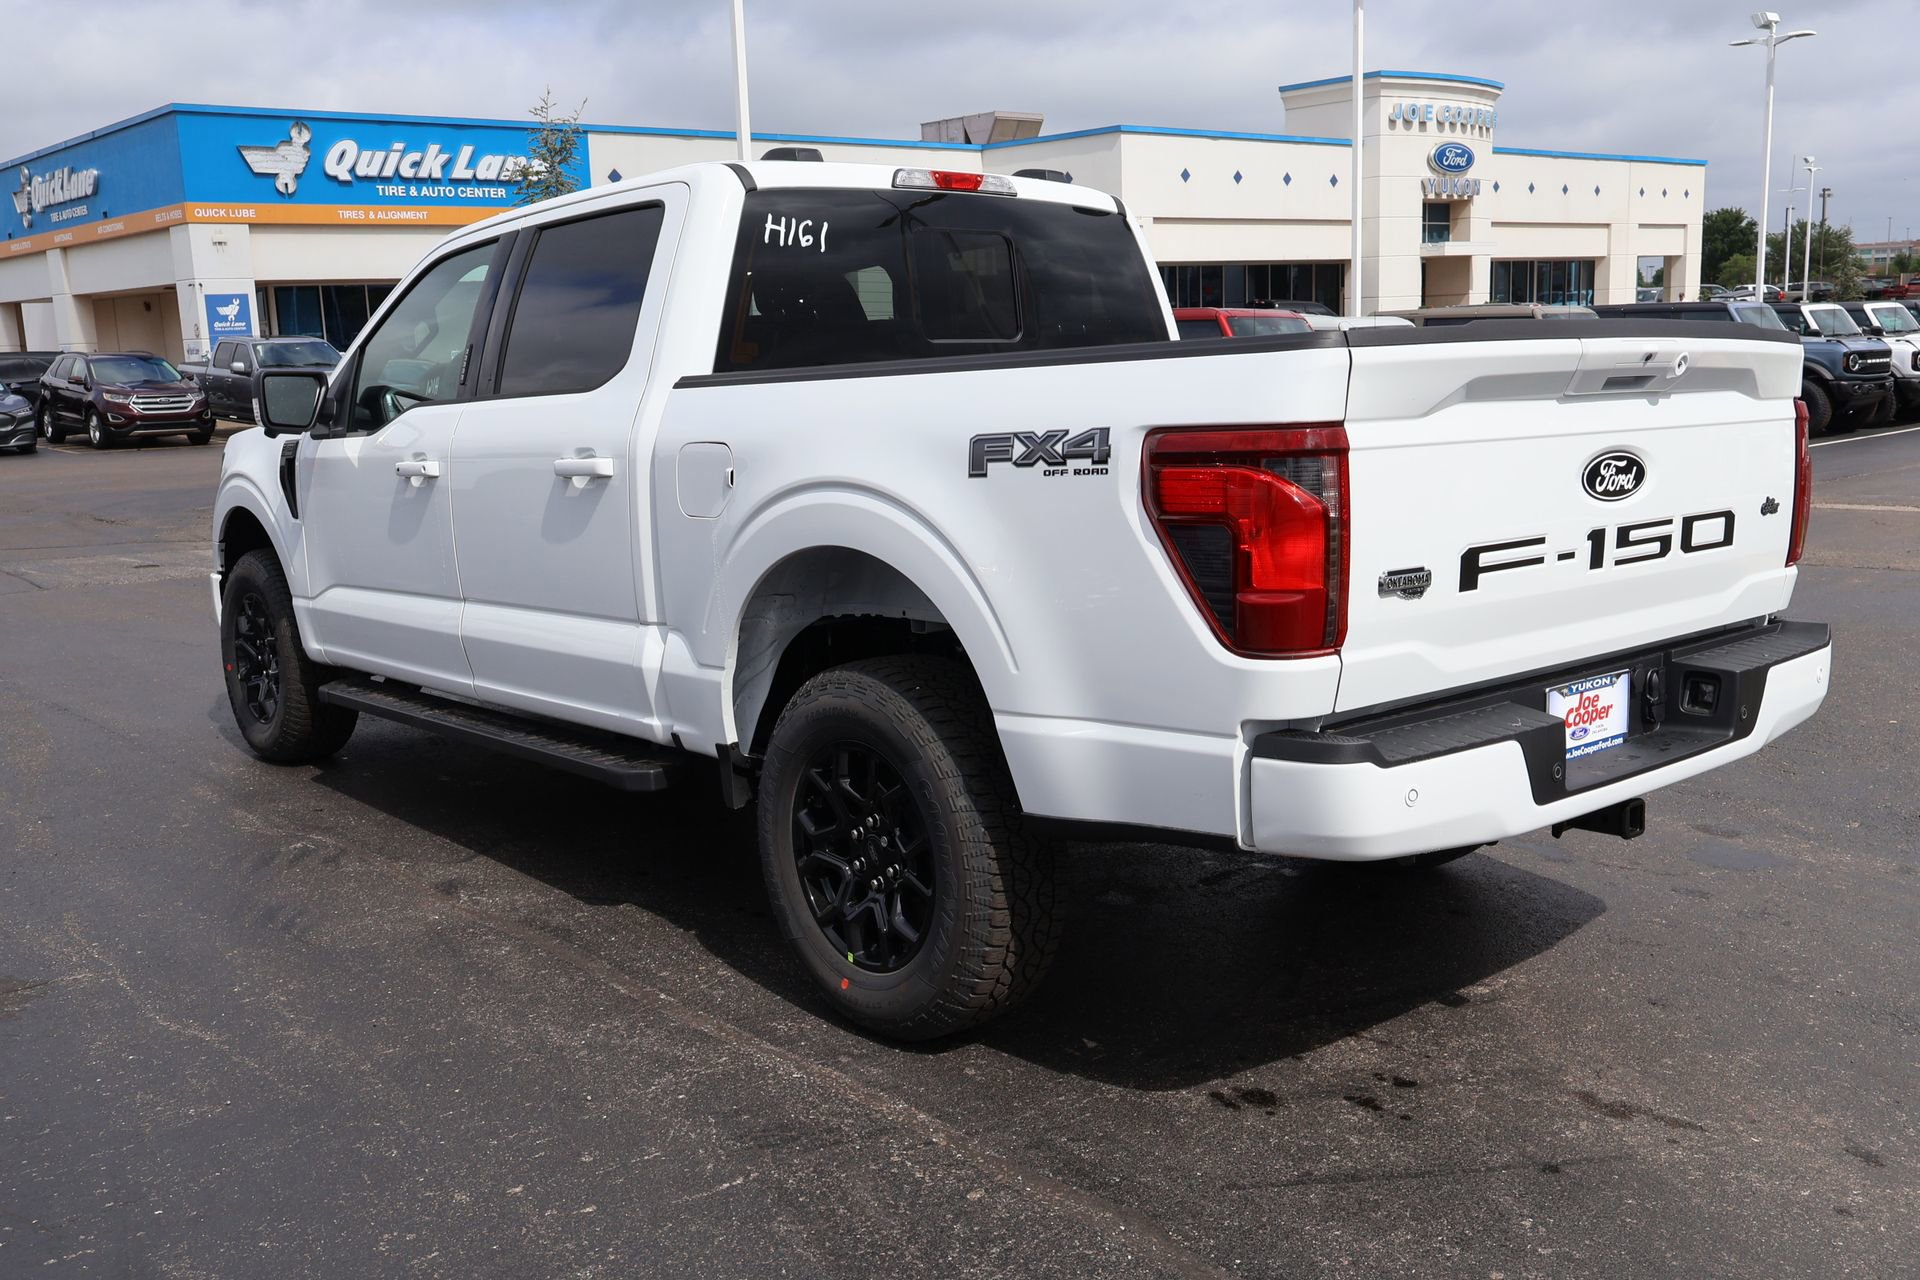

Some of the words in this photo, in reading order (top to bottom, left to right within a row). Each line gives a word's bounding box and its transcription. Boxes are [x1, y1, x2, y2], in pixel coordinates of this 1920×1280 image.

[1389, 103, 1434, 121] JOE
[1437, 105, 1498, 129] COOPER
[324, 139, 451, 182] Quick
[1443, 148, 1468, 166] Ford
[31, 167, 64, 213] Quick
[63, 166, 98, 202] Lane
[376, 185, 407, 197] TIRE
[409, 186, 419, 197] &
[421, 186, 455, 197] AUTO
[457, 186, 506, 198] CENTER
[1421, 179, 1480, 195] YUKON
[194, 208, 227, 217] QUICK
[229, 208, 256, 218] LUBE
[338, 210, 365, 219] TIRES
[368, 211, 376, 219] &
[377, 211, 428, 220] ALIGNMENT
[764, 213, 828, 253] H161
[968, 426, 1111, 479] FX4
[1043, 468, 1069, 477] OFF
[1073, 467, 1109, 476] ROAD
[1595, 459, 1637, 493] Ford
[1458, 508, 1736, 593] F-150
[1386, 572, 1430, 589] OKLAHOMA
[1571, 676, 1611, 693] YUKON
[1575, 692, 1600, 713] Joe
[1565, 704, 1613, 729] Cooper
